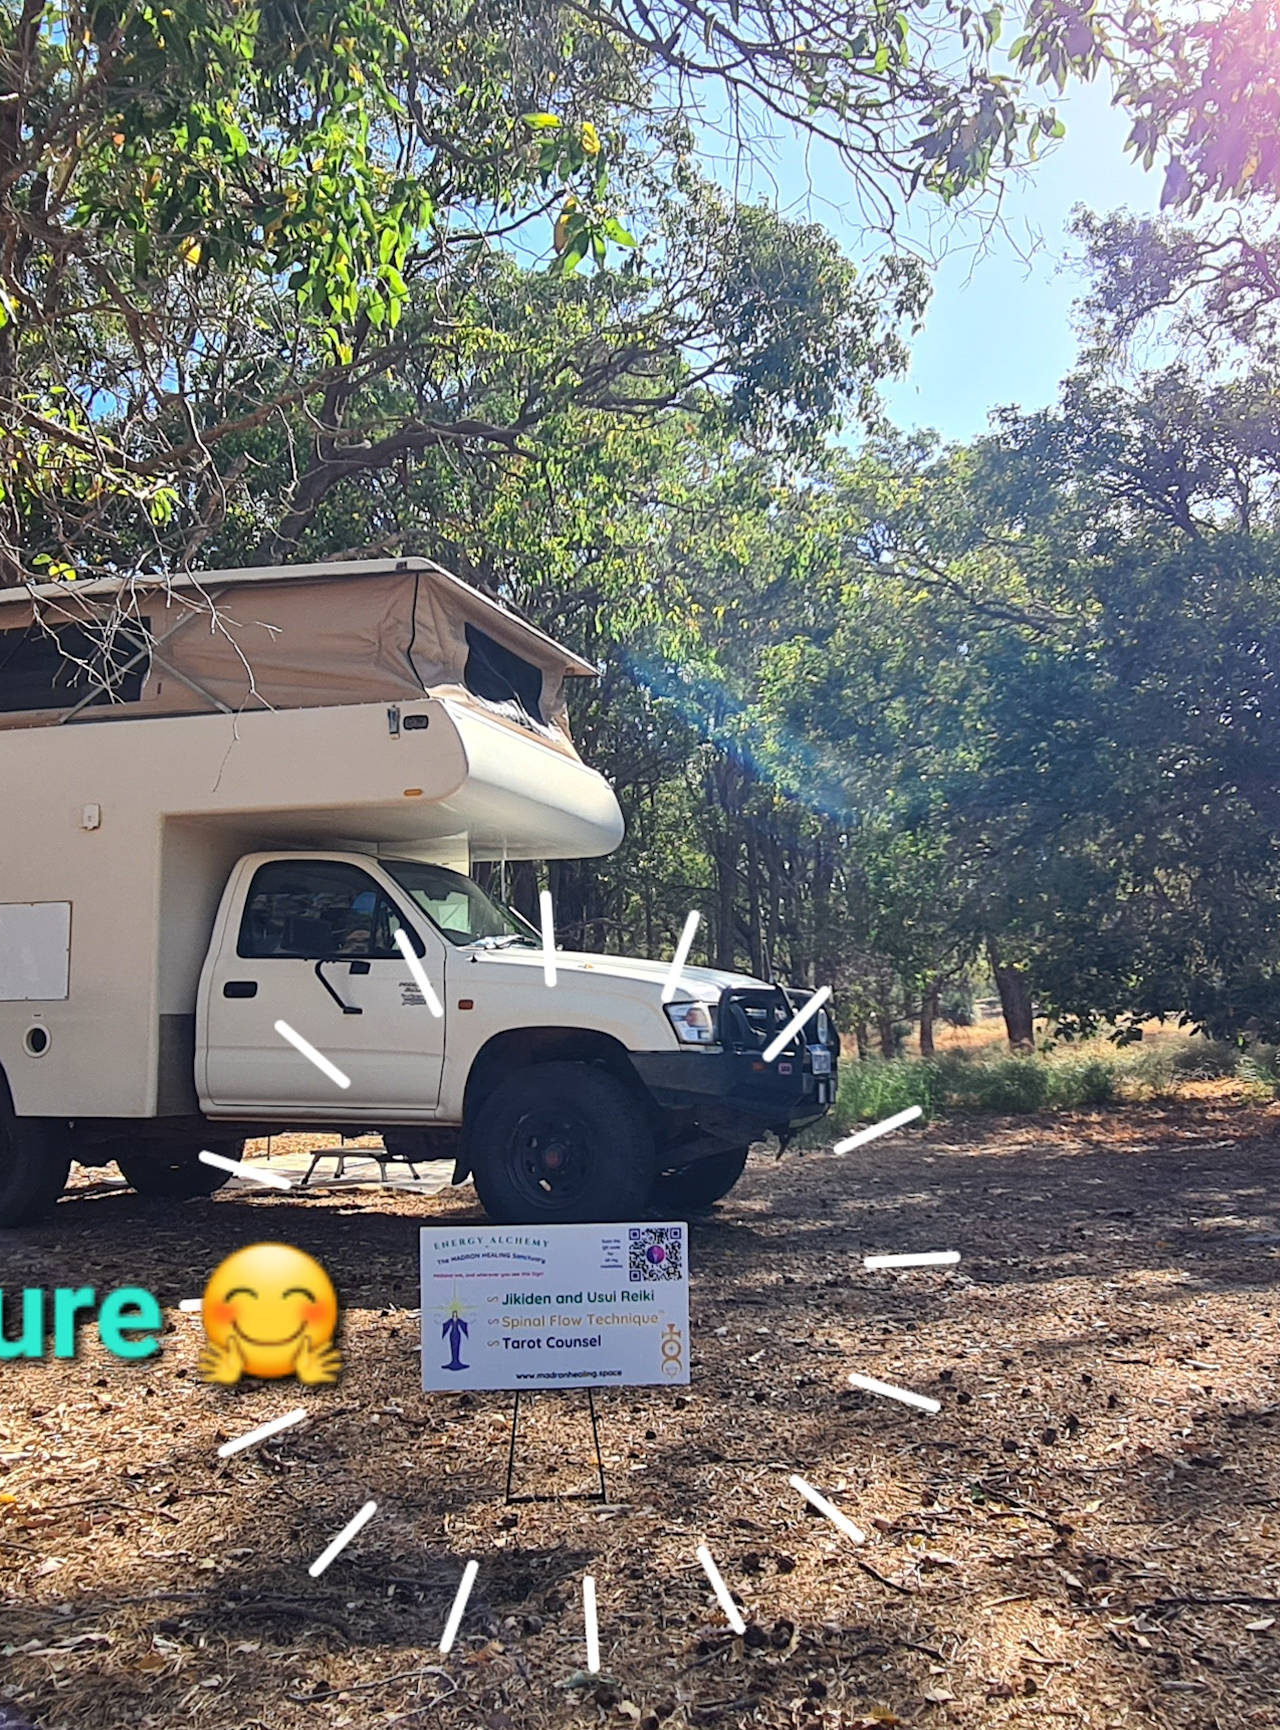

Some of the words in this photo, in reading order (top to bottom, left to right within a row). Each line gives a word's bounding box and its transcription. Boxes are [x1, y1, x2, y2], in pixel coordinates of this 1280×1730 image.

[434, 1237, 484, 1249] ENERGY
[490, 1236, 549, 1248] ALCHEMY
[502, 1292, 552, 1306] Jikiden
[556, 1291, 584, 1305] and
[587, 1291, 617, 1303] Usui
[621, 1290, 655, 1302] Reiki
[502, 1315, 545, 1330] Spinal
[549, 1314, 582, 1327] Flow
[502, 1337, 542, 1350] Tarot
[546, 1334, 602, 1349] Counsel
[516, 1369, 623, 1380] www.madronhealing.space
